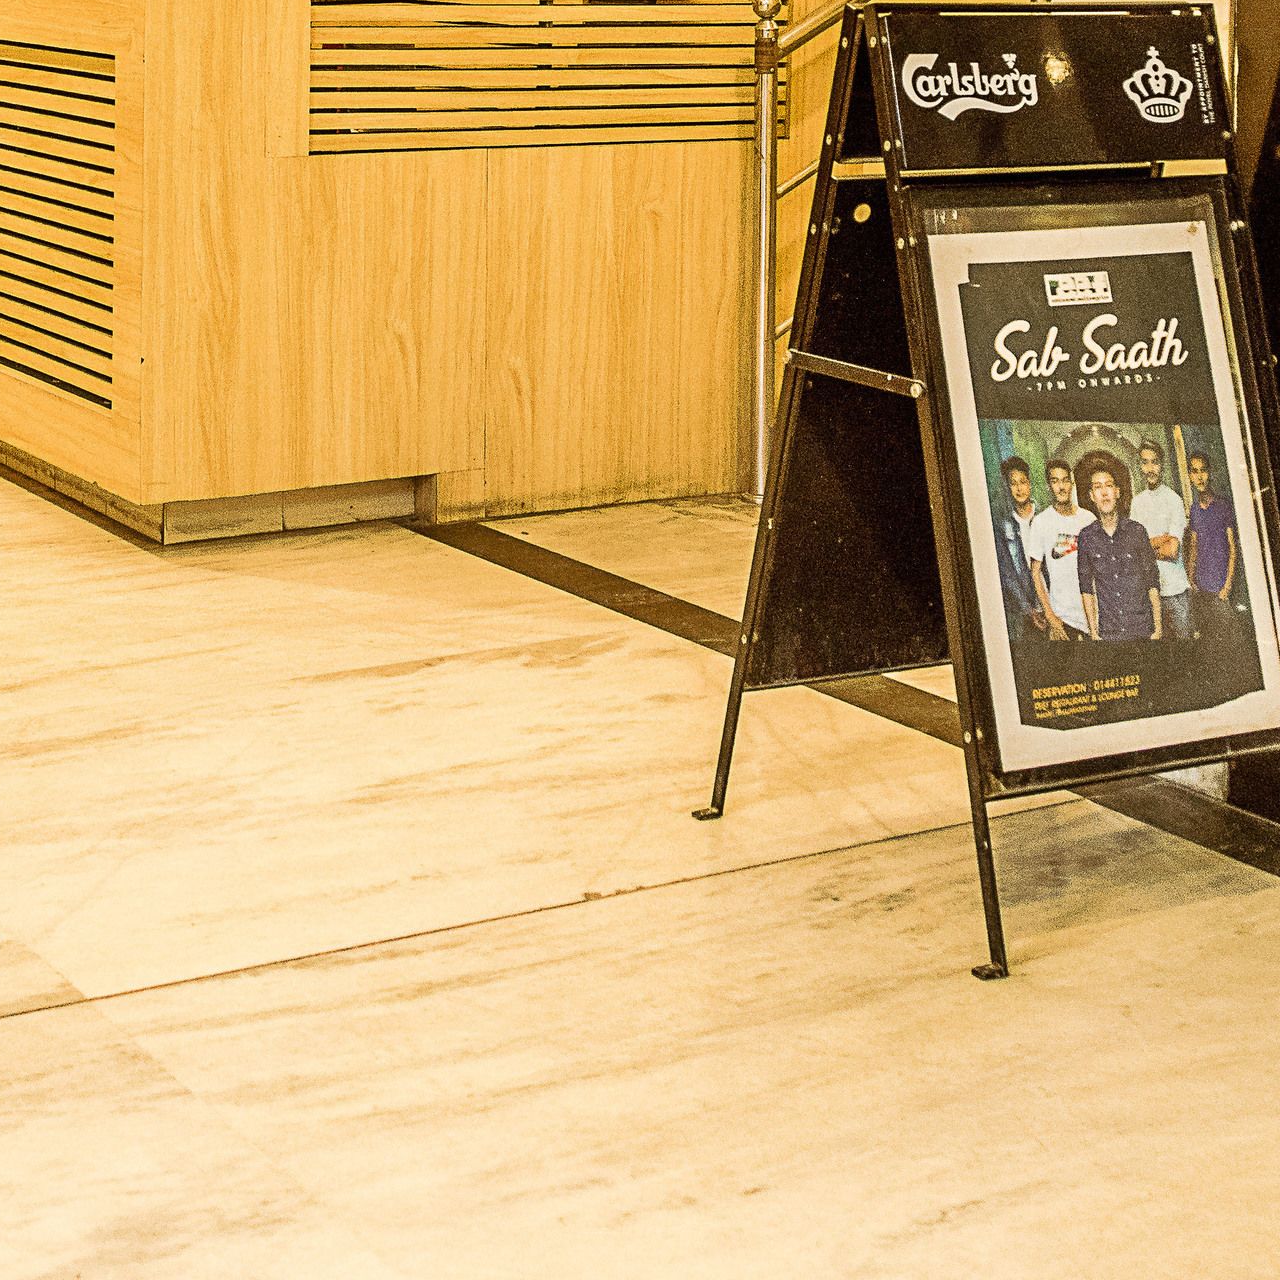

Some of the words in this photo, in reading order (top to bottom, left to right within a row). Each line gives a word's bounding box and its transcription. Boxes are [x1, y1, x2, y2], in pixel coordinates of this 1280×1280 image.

[902, 53, 1039, 112] Carlsberg
[990, 319, 1070, 382] Sab
[1079, 313, 1189, 375] Saath
[1032, 684, 1086, 698] RESERVATION
